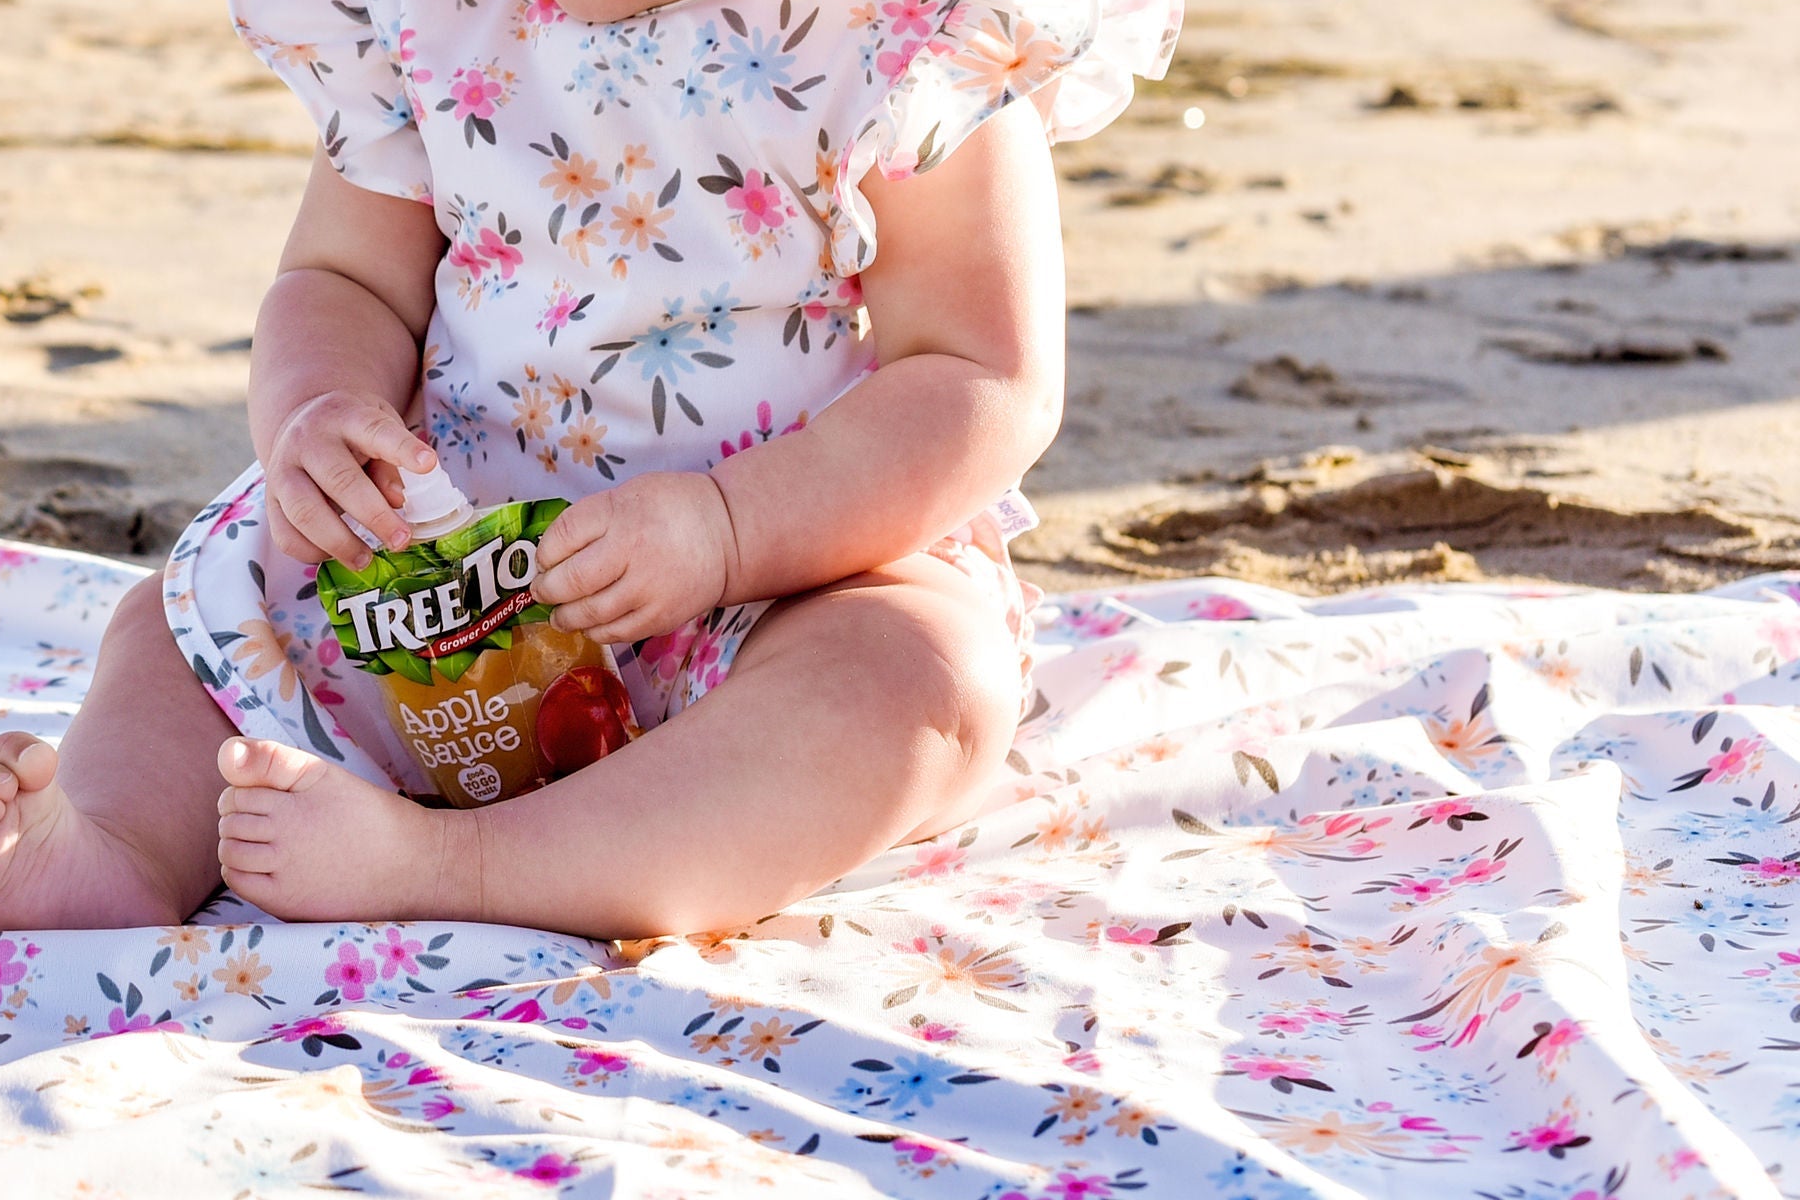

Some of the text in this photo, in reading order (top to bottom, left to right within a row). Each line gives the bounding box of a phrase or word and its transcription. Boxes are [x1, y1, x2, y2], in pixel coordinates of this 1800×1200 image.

[337, 535, 541, 654] TREE TO
[439, 628, 480, 652] Grower
[481, 599, 514, 632] Owned
[399, 688, 510, 739] Apple
[412, 725, 521, 769] Sauce
[463, 774, 497, 791] TO GO
